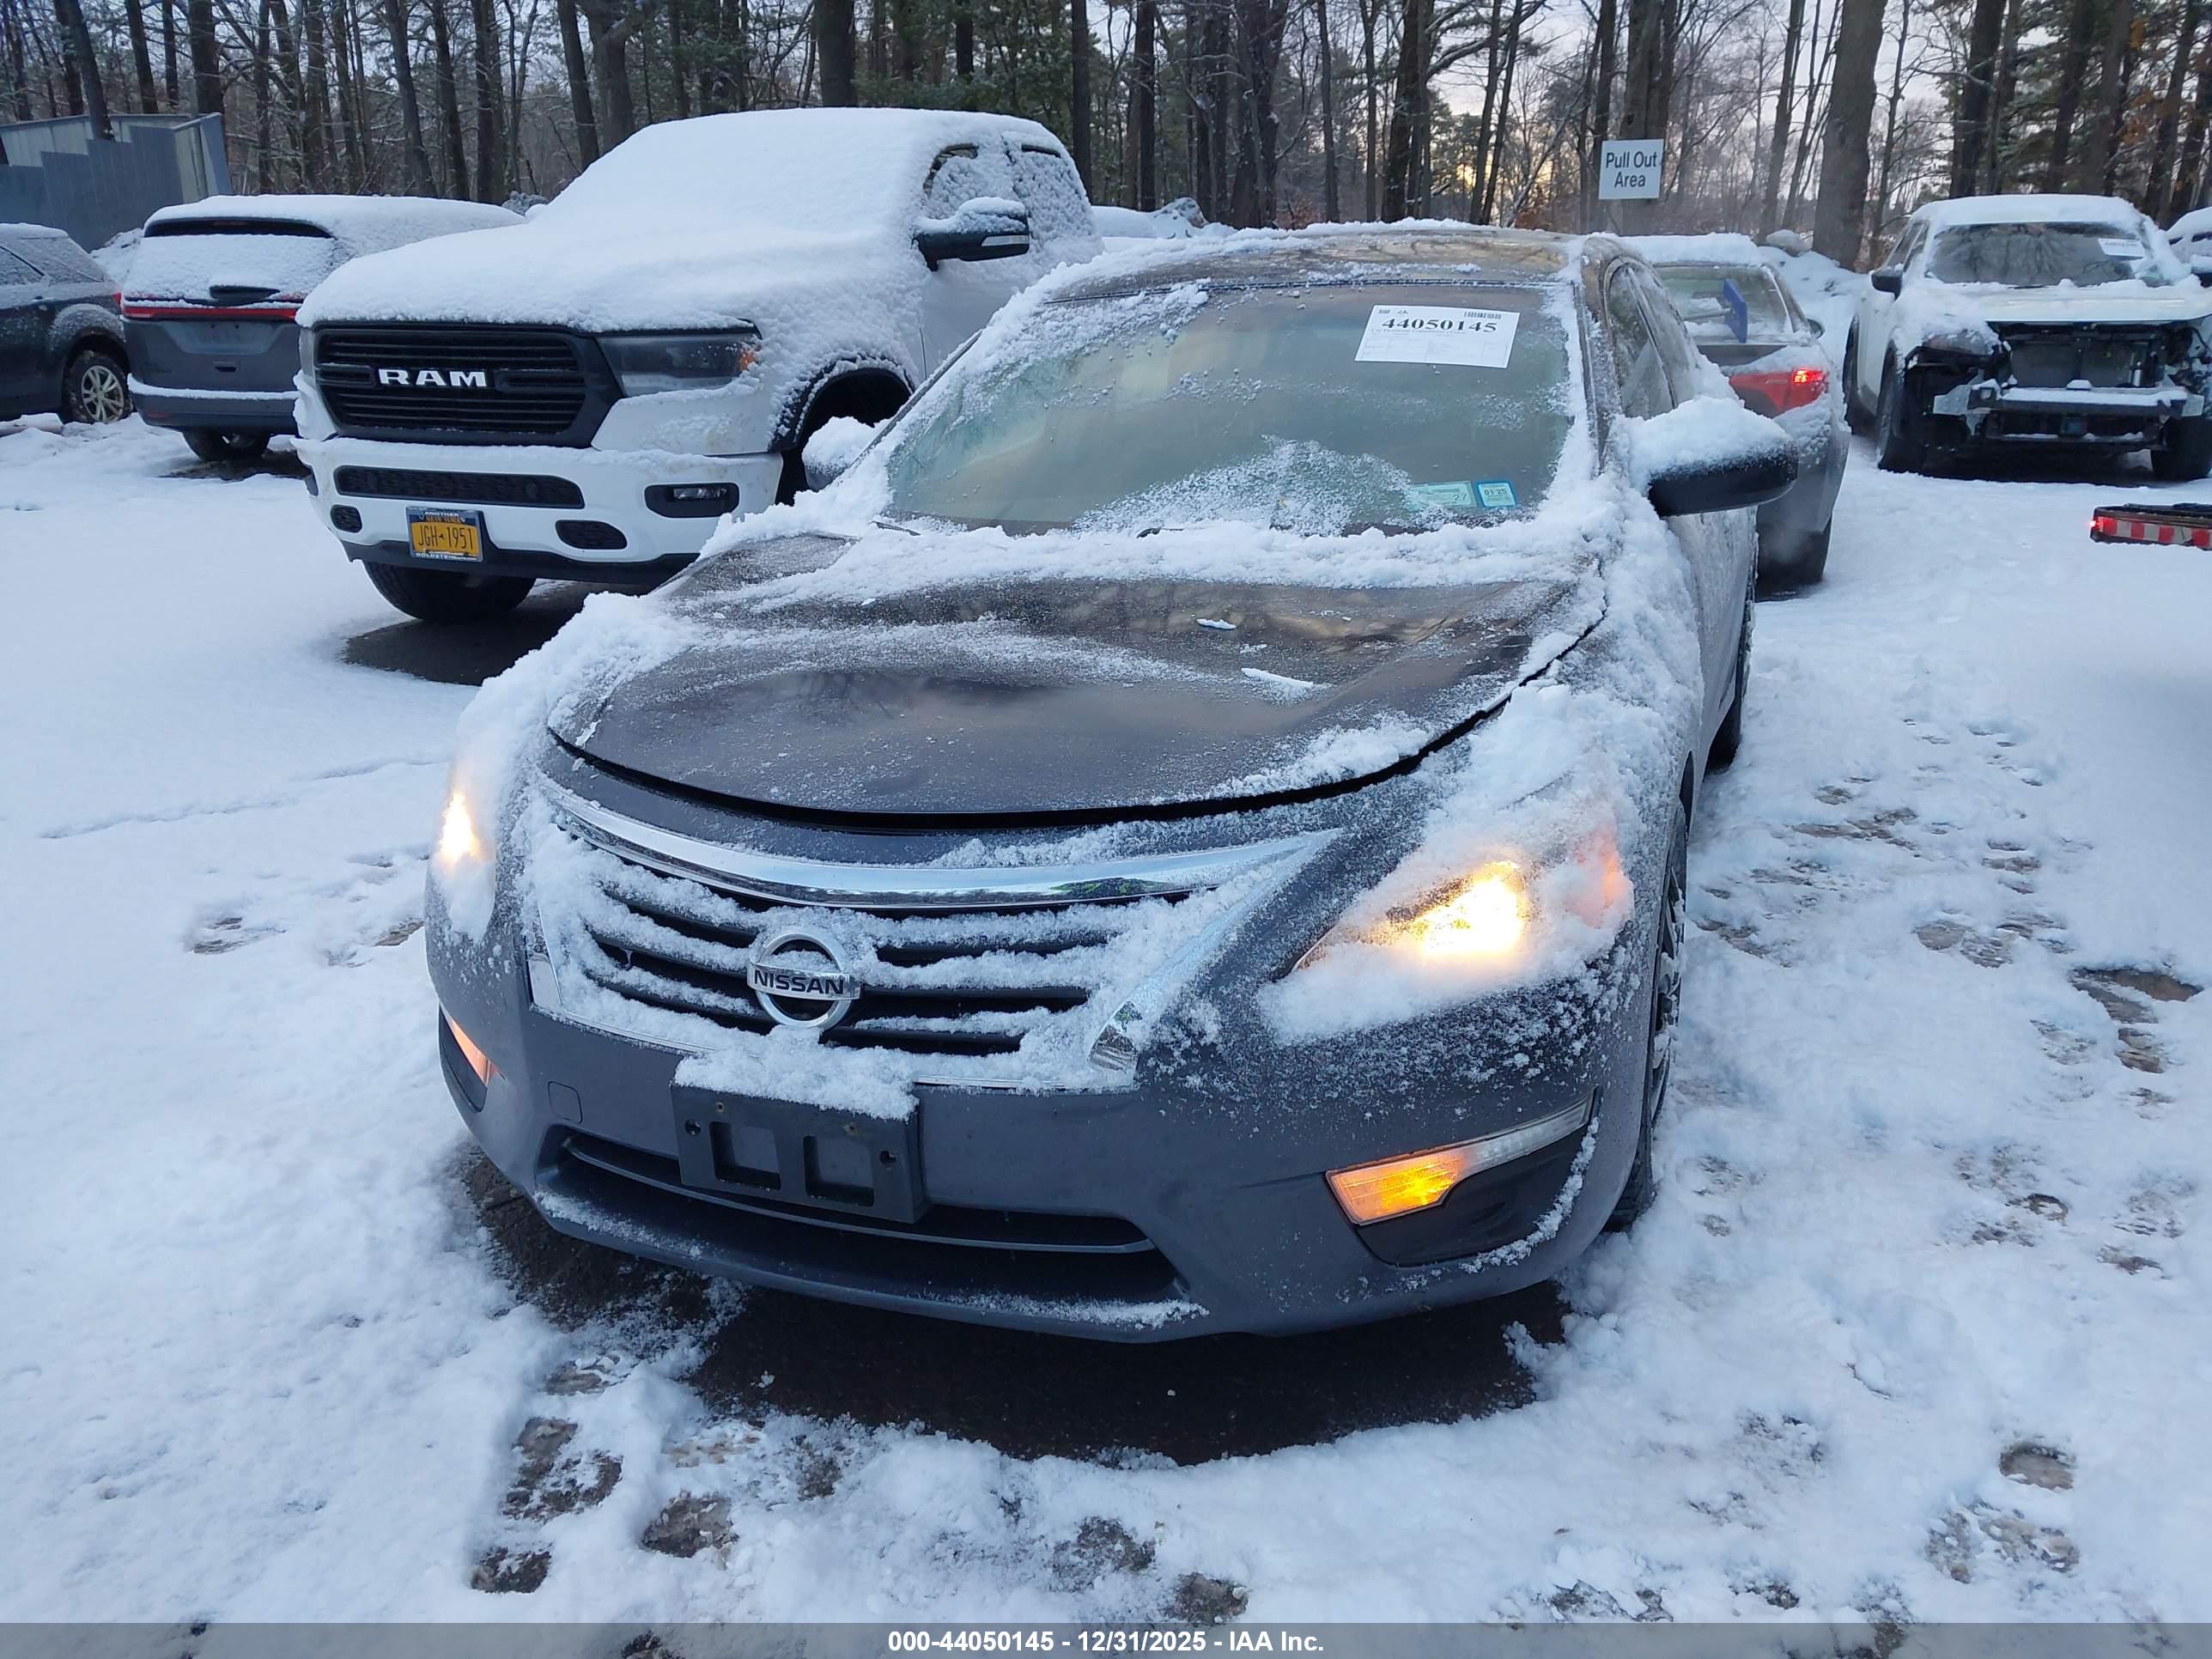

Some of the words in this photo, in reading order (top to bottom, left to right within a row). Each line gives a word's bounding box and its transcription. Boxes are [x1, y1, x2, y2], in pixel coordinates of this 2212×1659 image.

[1606, 151, 1630, 168] Pull
[1633, 151, 1657, 168] Out
[1614, 171, 1646, 187] Area
[1381, 318, 1498, 333] 44050145
[378, 368, 487, 386] RAM
[754, 969, 844, 994] NISSAN
